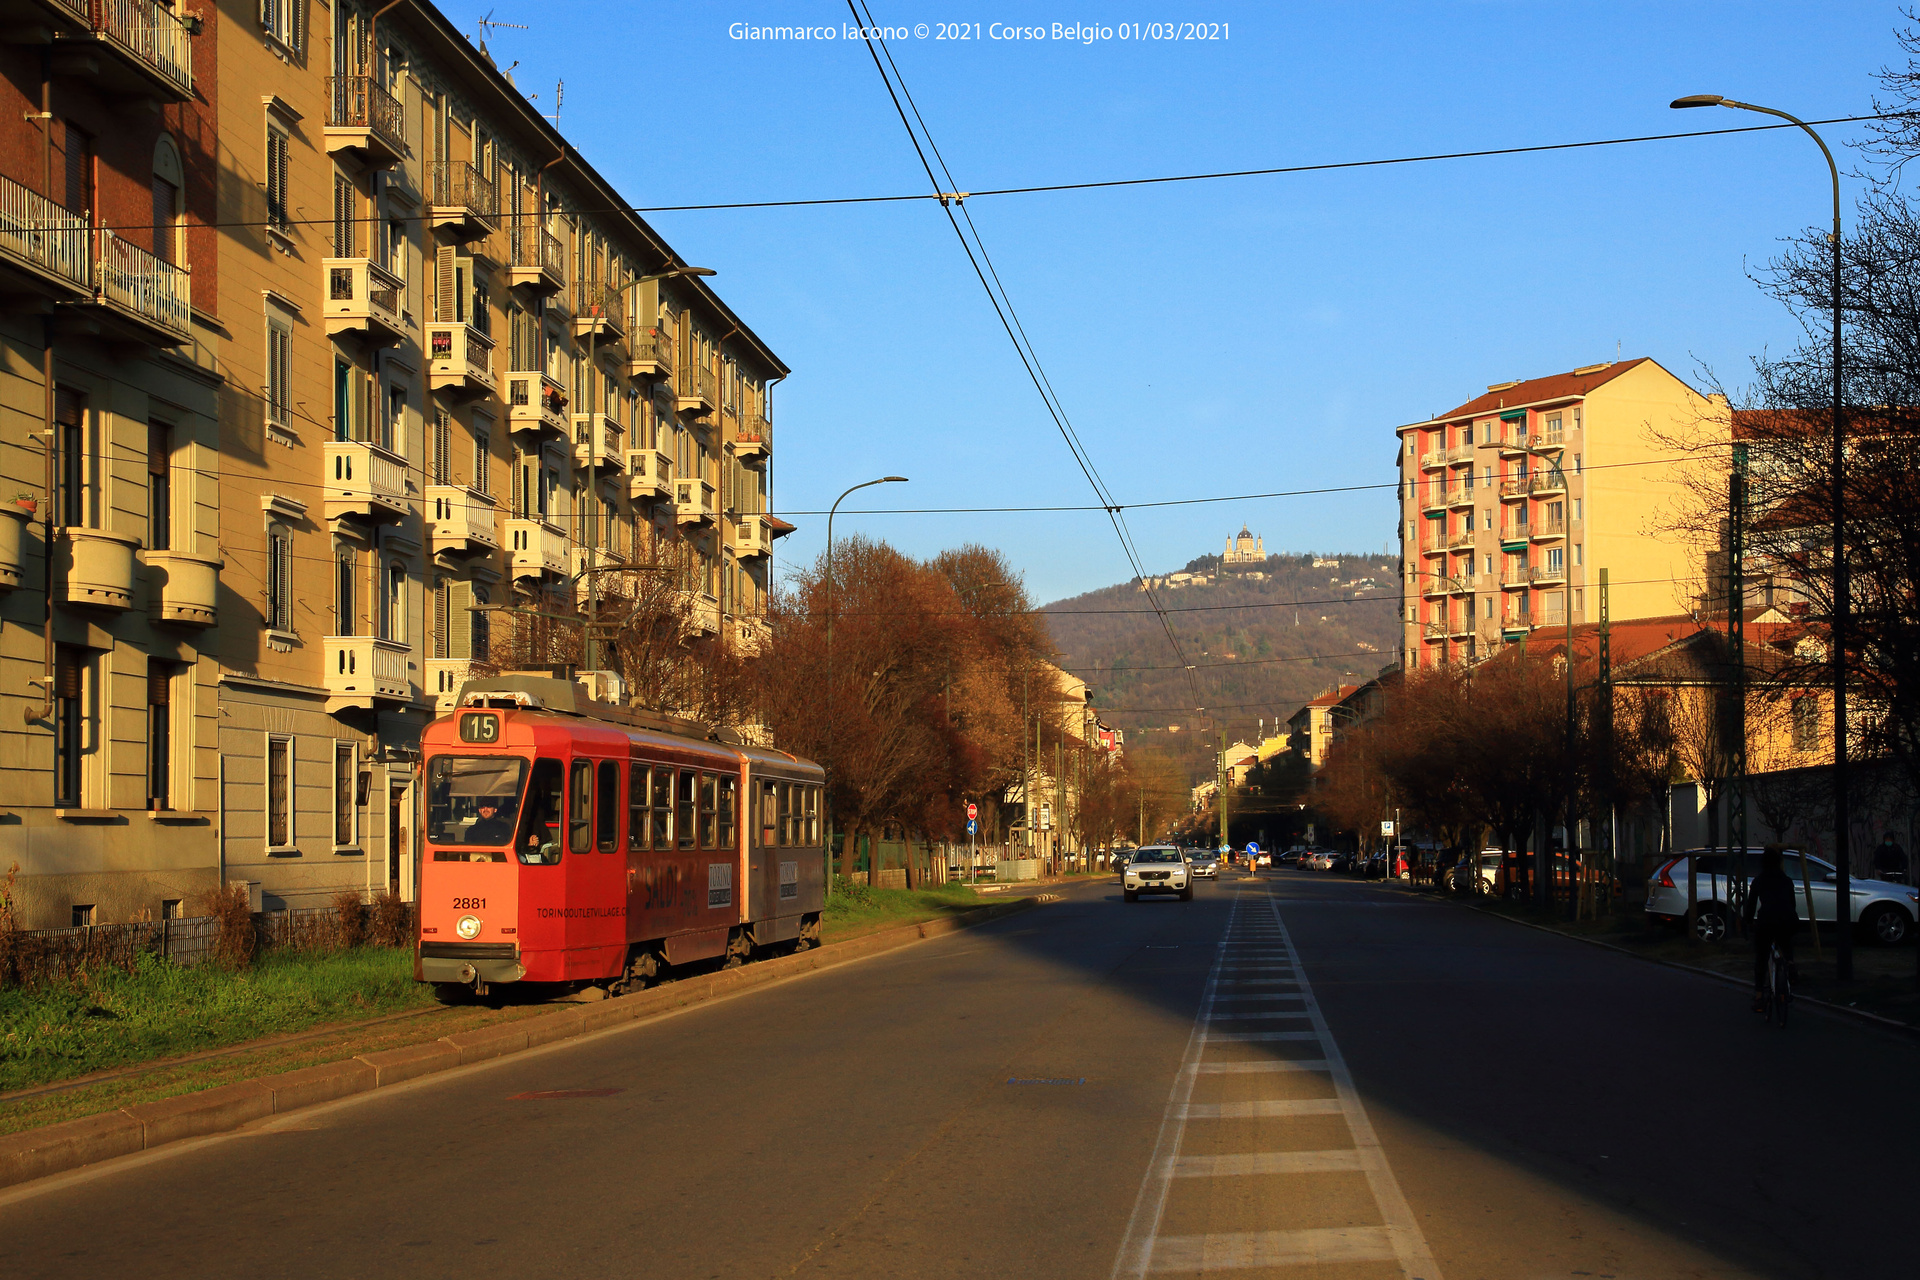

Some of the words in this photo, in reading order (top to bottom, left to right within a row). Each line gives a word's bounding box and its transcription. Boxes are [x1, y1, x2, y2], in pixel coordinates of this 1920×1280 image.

[471, 716, 495, 739] 15
[645, 865, 678, 910] SALDI
[709, 865, 732, 888] TORINO
[453, 897, 486, 909] 2881
